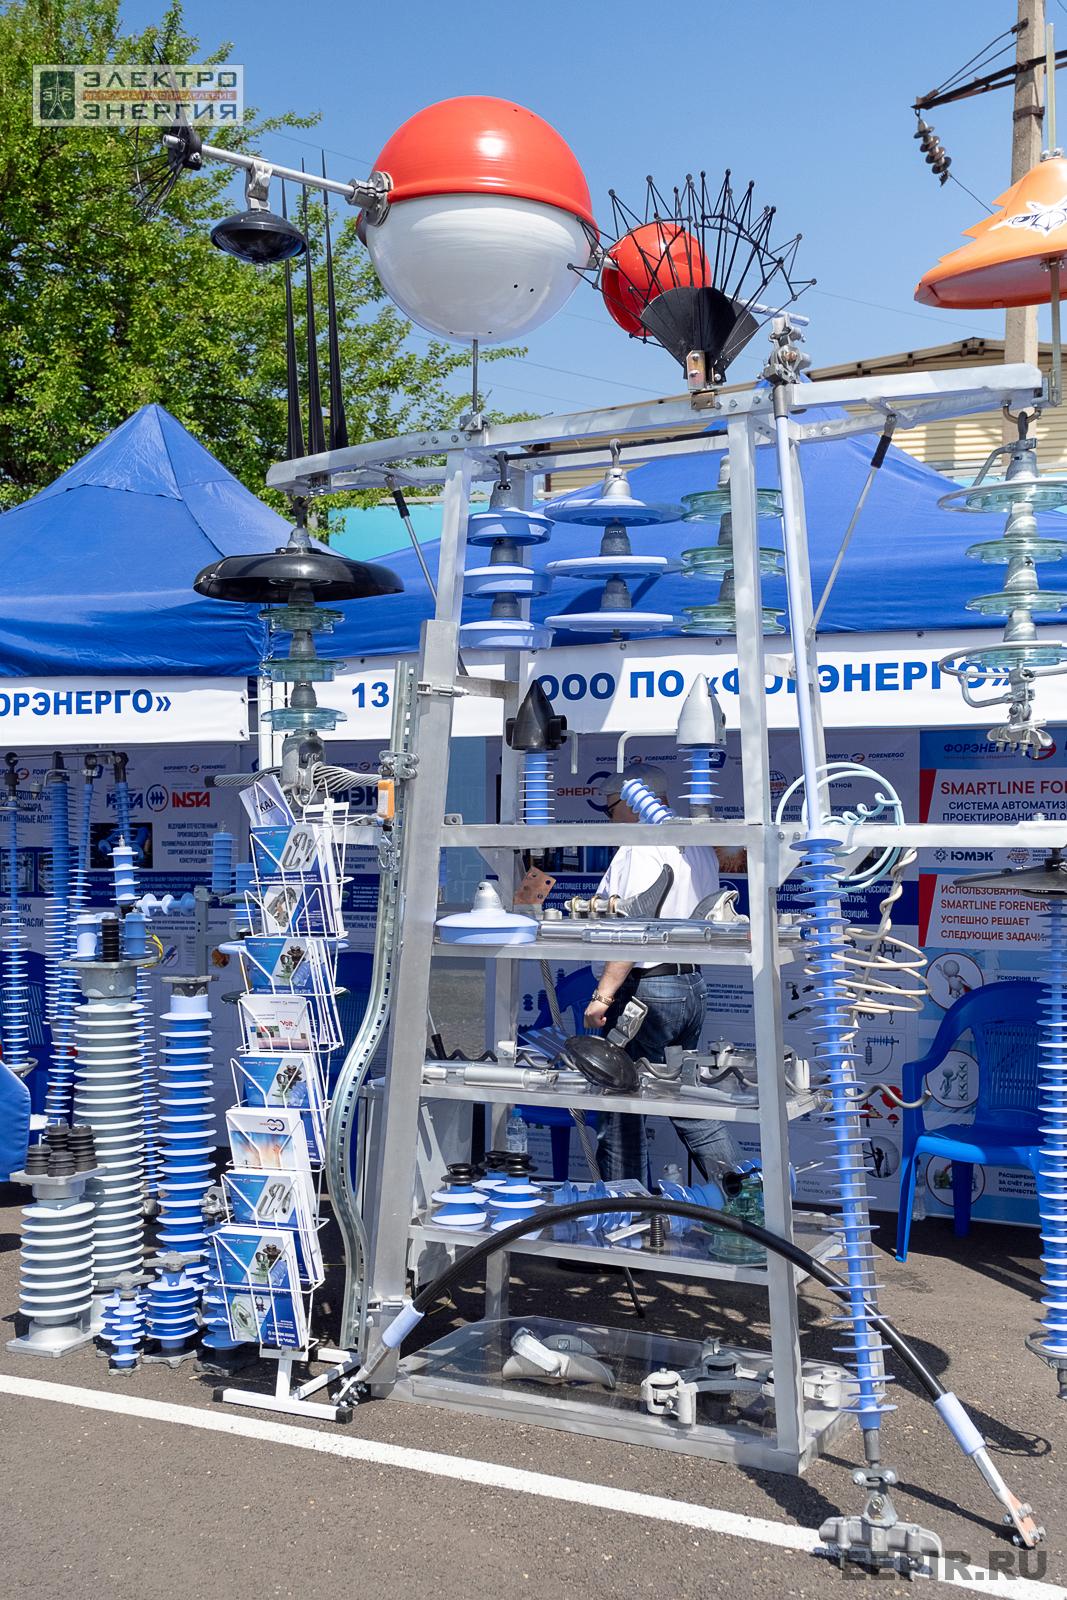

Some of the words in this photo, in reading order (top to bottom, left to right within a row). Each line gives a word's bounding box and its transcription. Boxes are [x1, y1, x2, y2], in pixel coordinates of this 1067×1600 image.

[538, 672, 616, 702] ООО
[629, 669, 685, 699] ПО
[351, 681, 391, 708] 13
[556, 787, 598, 797] ЭНЕРГ
[940, 780, 1035, 796] SMARTLINE
[172, 791, 211, 808] INSTA
[948, 801, 999, 811] СИСТЕМА
[942, 812, 1033, 822] ПРОЕКТИРОВАНИ
[950, 851, 994, 862] ЮМЭК
[940, 885, 1021, 896] ИСПОЛЬЗОВАНИ
[940, 899, 997, 911] SMARTLINE
[940, 915, 989, 925] УСПЕШНО
[991, 917, 1030, 926] РЕШАЕТ
[940, 930, 1004, 941] СЛЕДУЮЩИЕ
